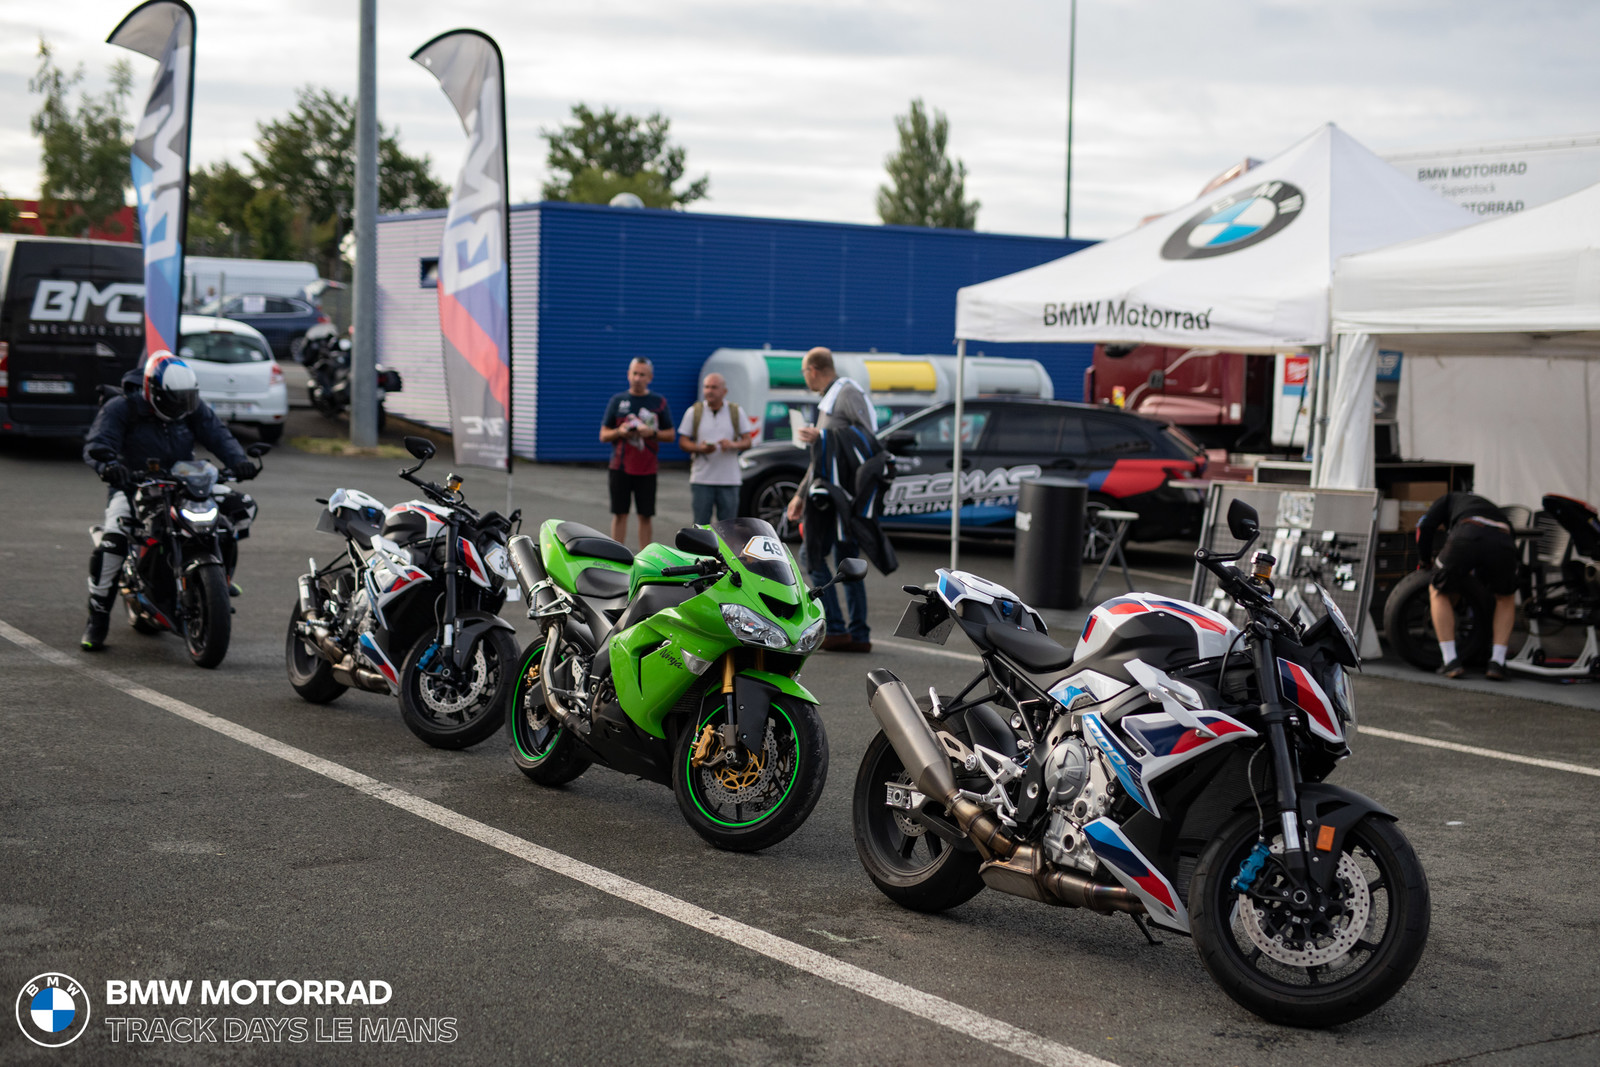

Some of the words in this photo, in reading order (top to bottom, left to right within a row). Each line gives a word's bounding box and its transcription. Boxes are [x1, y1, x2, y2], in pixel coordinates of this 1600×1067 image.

[1417, 167, 1449, 182] BMW
[1451, 162, 1528, 179] MOTORRAD
[30, 280, 146, 324] BMC
[1044, 300, 1101, 327] BMW
[1106, 300, 1213, 330] Motorrad
[763, 541, 784, 557] 49
